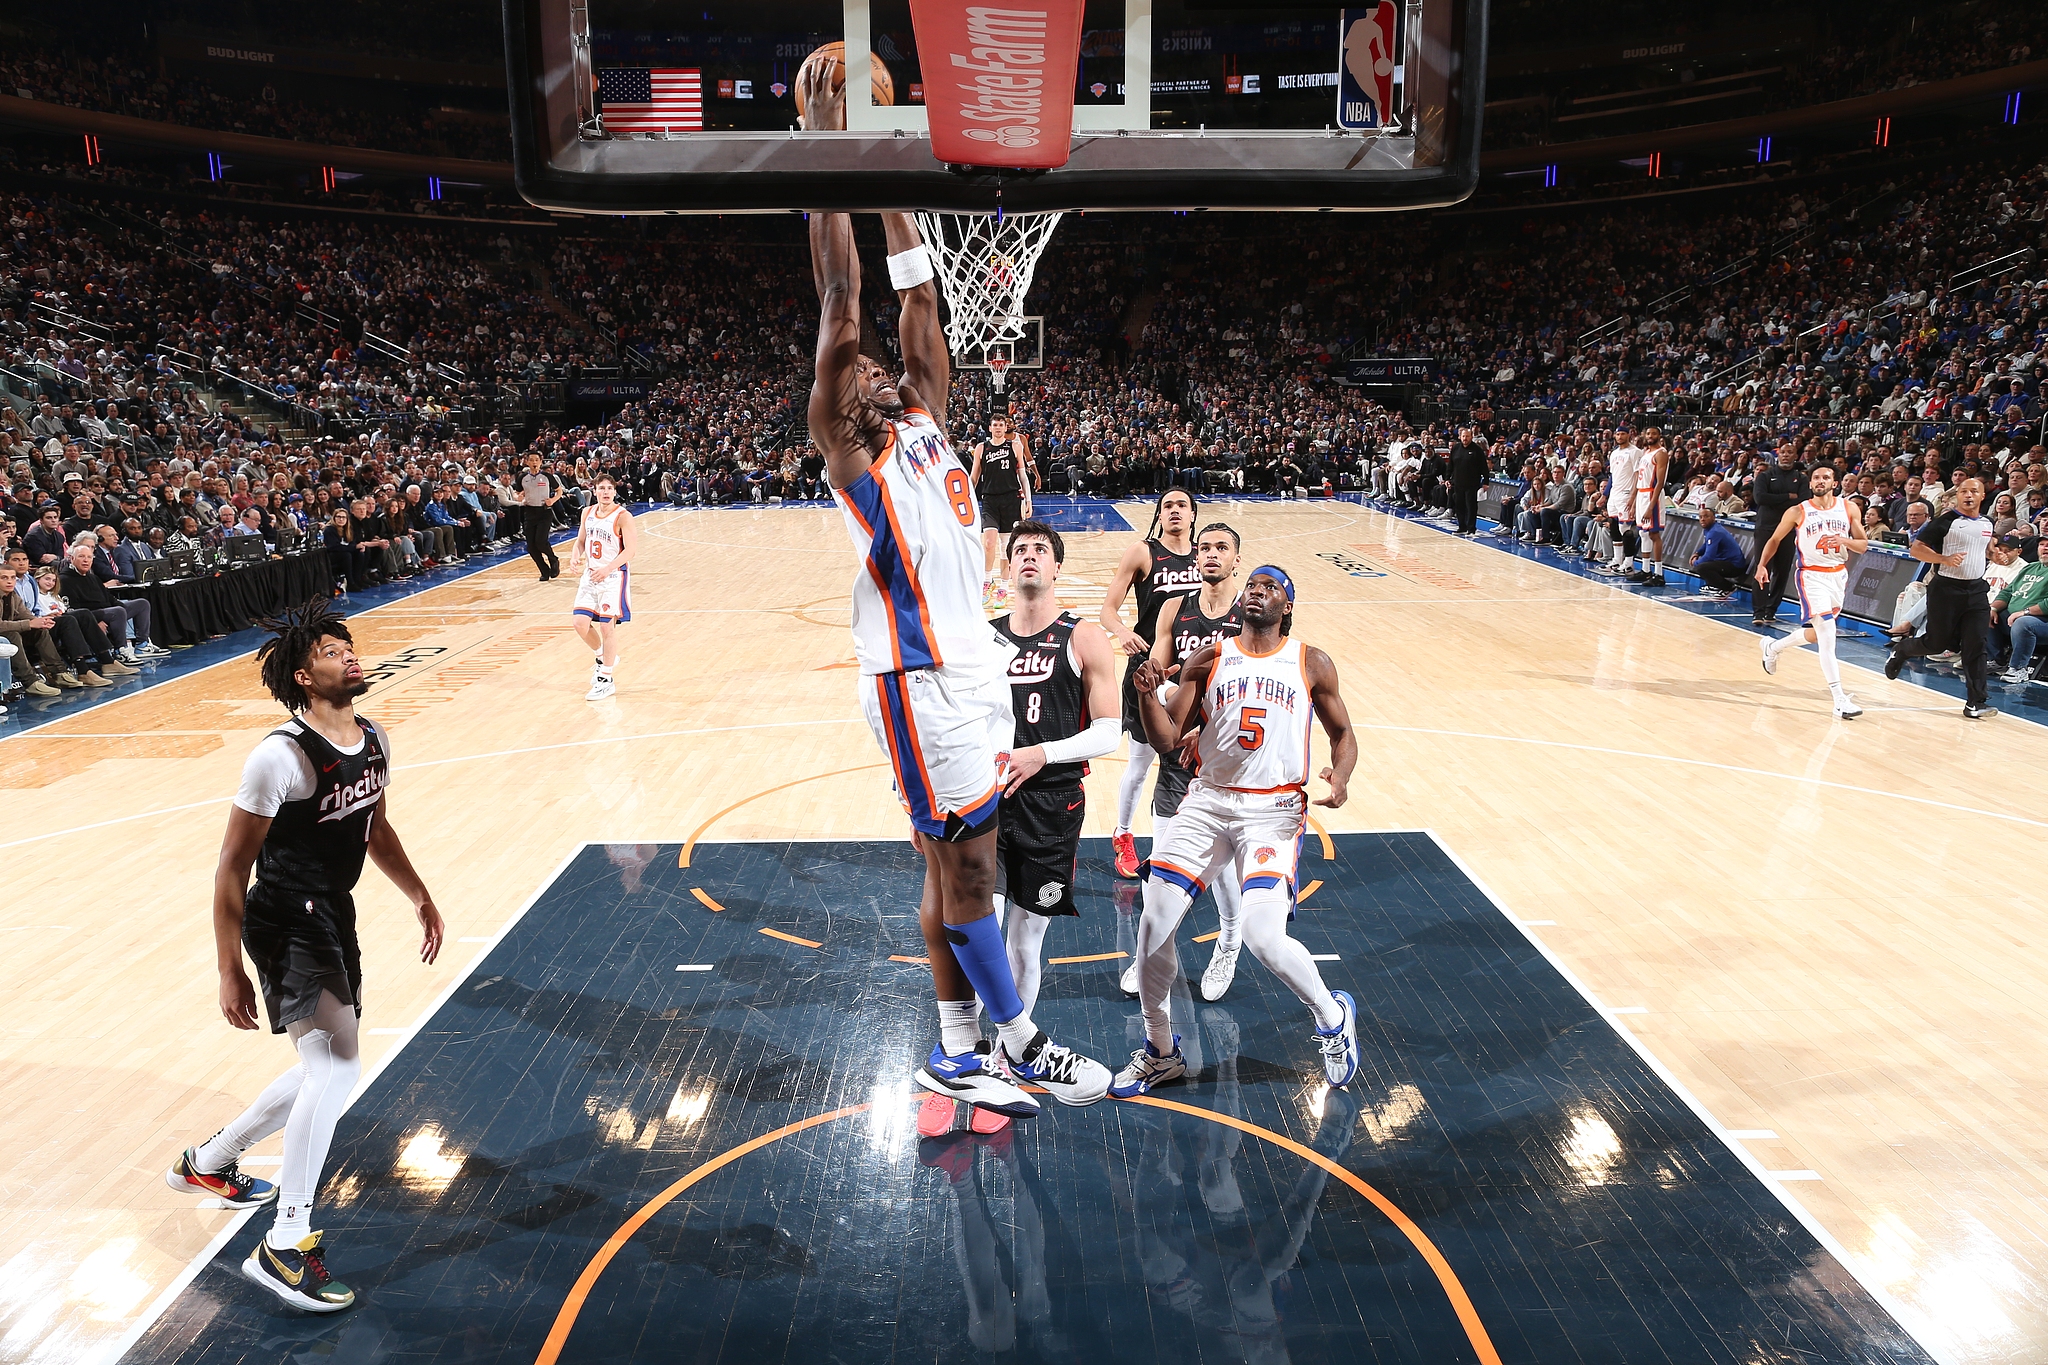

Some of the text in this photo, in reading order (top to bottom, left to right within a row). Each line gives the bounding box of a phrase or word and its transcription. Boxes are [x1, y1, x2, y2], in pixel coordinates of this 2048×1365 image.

[207, 46, 235, 60] BUD
[237, 49, 275, 64] LIGHT
[1623, 47, 1648, 59] BUD
[1649, 42, 1685, 57] LIGHT
[1278, 72, 1339, 89] TASTE IS EVERYTHIN
[1345, 101, 1371, 122] NBA
[1353, 365, 1428, 377] Michelob ULTRA
[577, 386, 641, 396] Michelob ULTRA
[1000, 459, 1010, 470] 23
[944, 467, 975, 528] 8
[1805, 519, 1848, 538] NEW YORK
[589, 539, 603, 560] 13
[1153, 565, 1204, 593] ripcit
[1175, 628, 1228, 656] ripcit
[364, 646, 449, 685] CHAS
[1008, 650, 1057, 683] city
[1216, 676, 1297, 715] NEW YORK
[1026, 692, 1042, 725] 8
[1237, 706, 1267, 751] 5
[319, 764, 386, 823] ripcity
